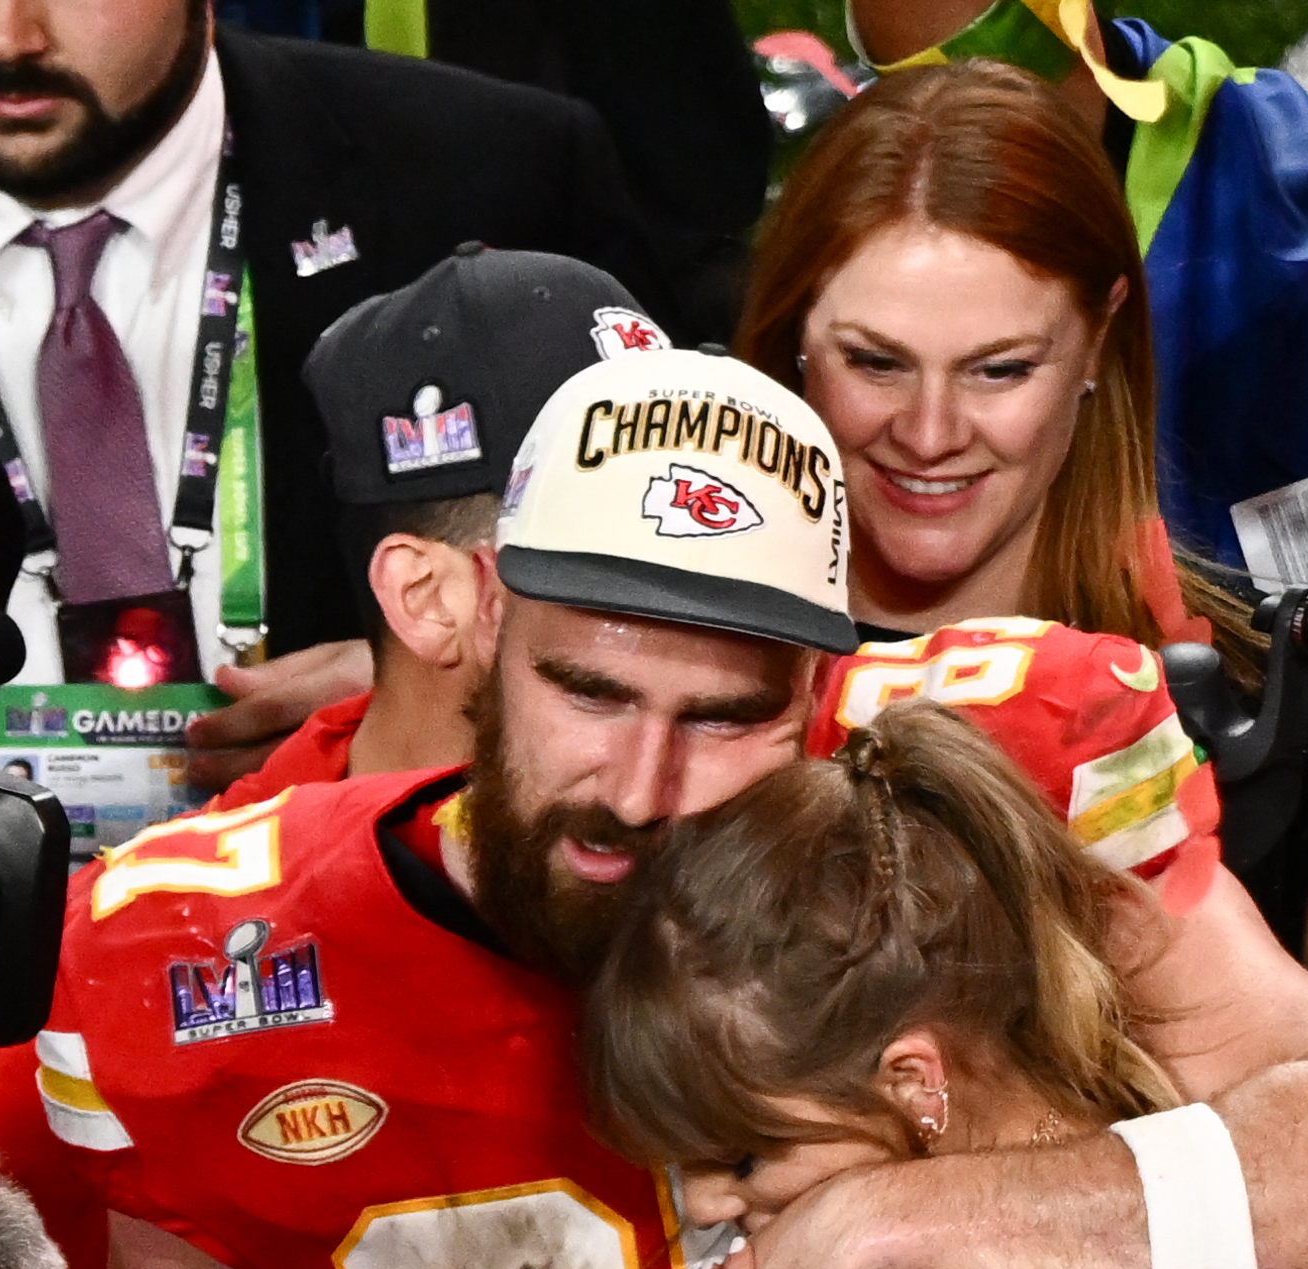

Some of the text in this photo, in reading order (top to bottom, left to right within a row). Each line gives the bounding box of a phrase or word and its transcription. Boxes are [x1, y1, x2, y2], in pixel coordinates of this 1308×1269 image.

[219, 183, 242, 249] USHER
[198, 341, 223, 409] USHER
[648, 387, 783, 428] SUPER BOWL
[576, 399, 832, 524] CHAMPIONS
[670, 479, 740, 530] KC
[72, 709, 209, 734] GAMED
[187, 1018, 247, 1039] SUPER
[276, 1100, 352, 1145] NKH
